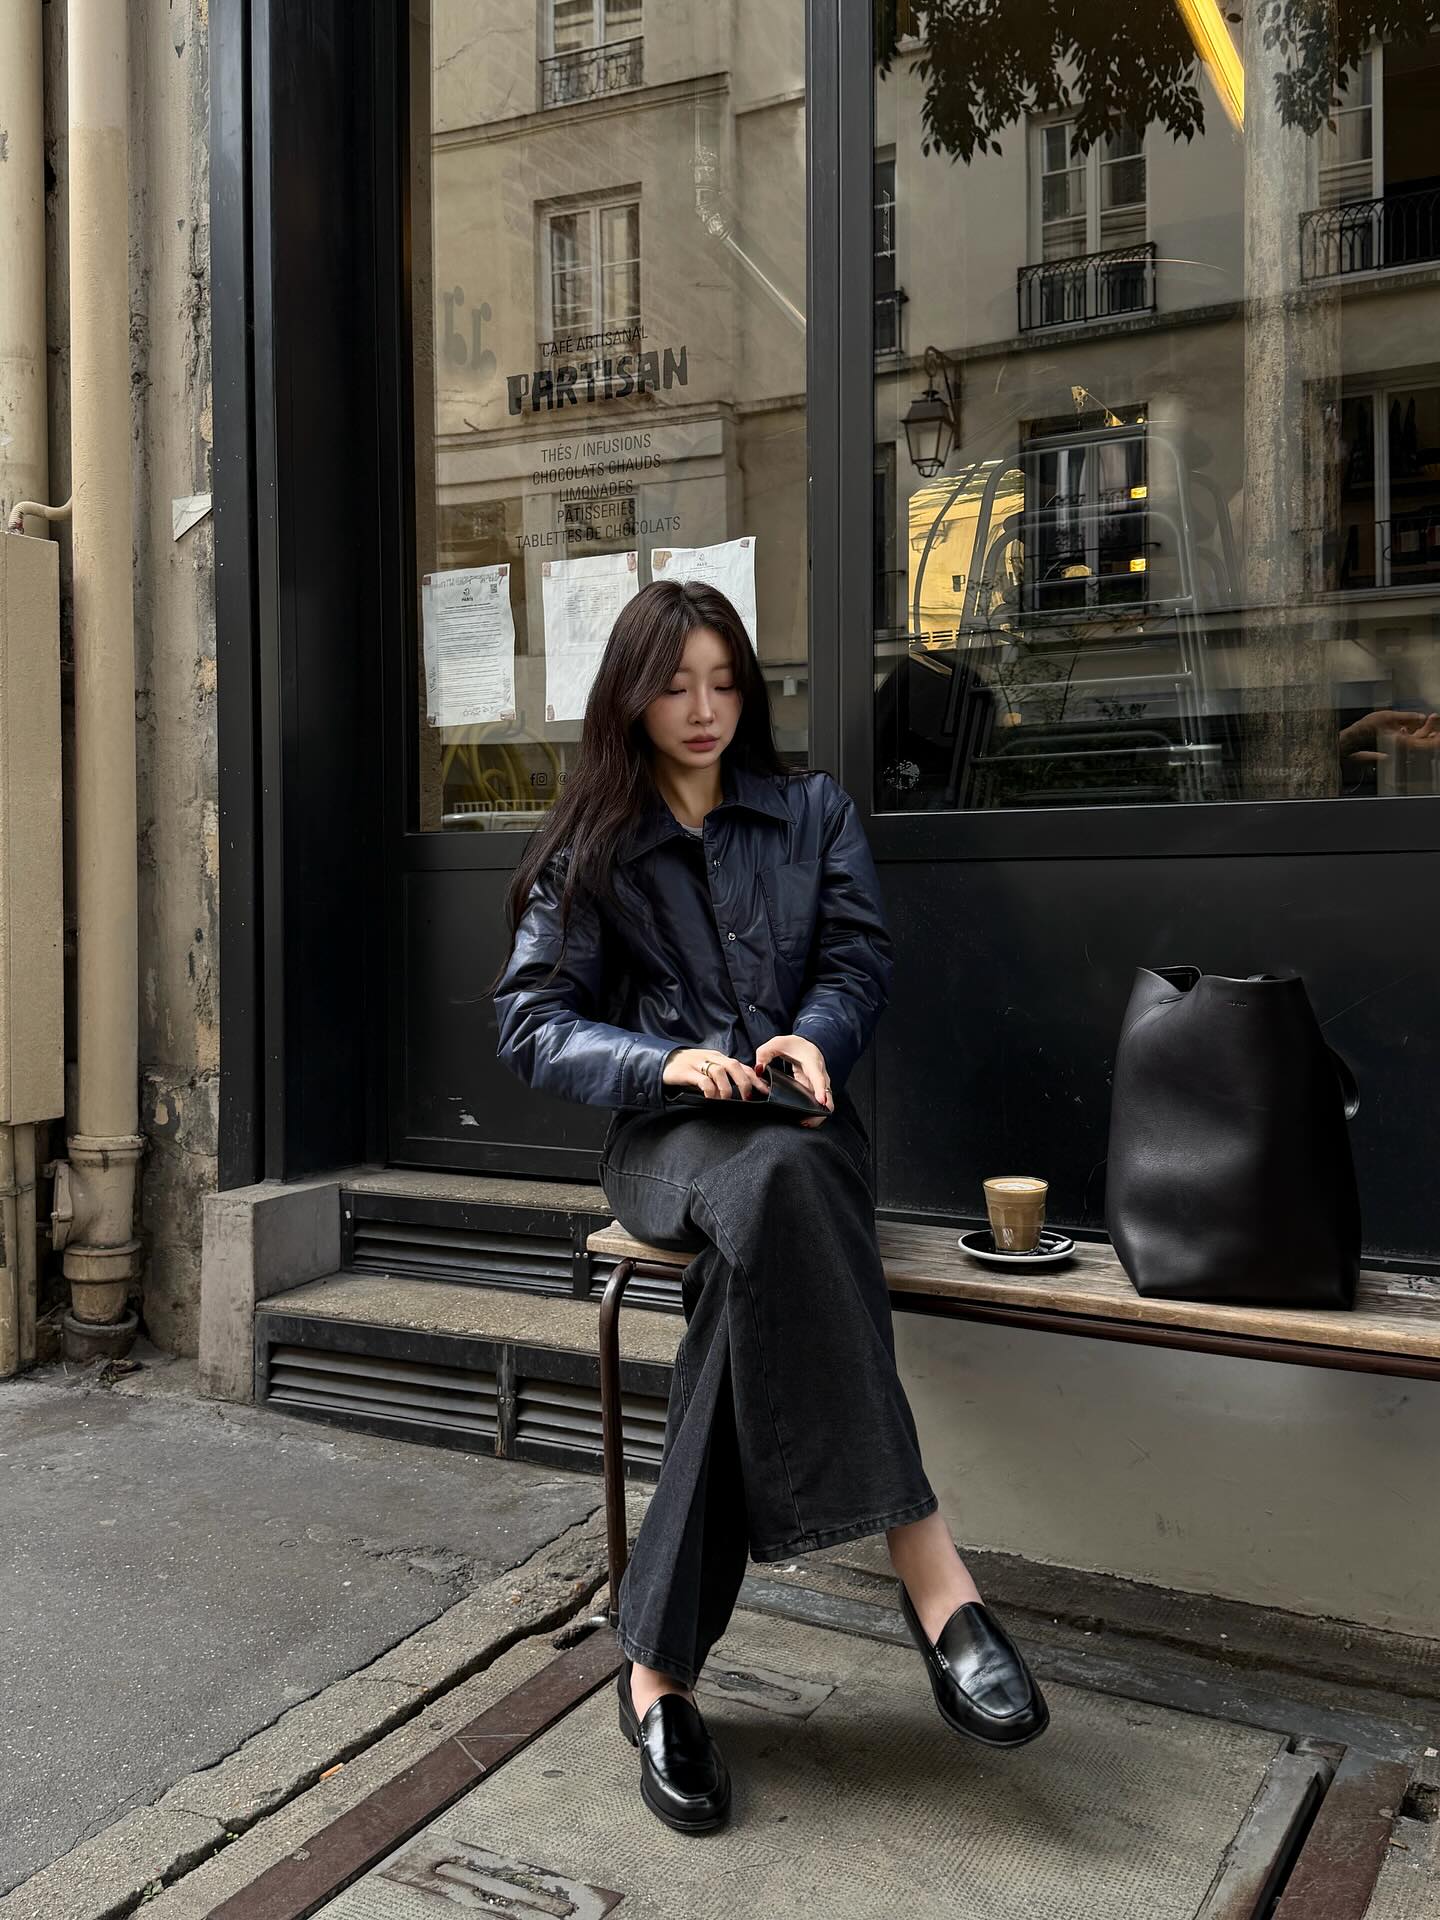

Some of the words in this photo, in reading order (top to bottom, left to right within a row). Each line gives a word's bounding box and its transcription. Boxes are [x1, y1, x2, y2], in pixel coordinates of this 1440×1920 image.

[543, 336, 573, 358] CAFÉ
[576, 326, 649, 351] ARTISANAL
[506, 345, 688, 416] PARTISAN
[541, 443, 572, 463] THÉS
[583, 433, 651, 457] INFUSIONS
[532, 462, 605, 485] CHOCOLATS
[608, 453, 662, 474] CHAUDS
[559, 479, 633, 503] LIMONADES
[516, 527, 582, 549] TABLETTES
[586, 525, 602, 541] DE
[605, 516, 681, 540] CHOCOLATS
